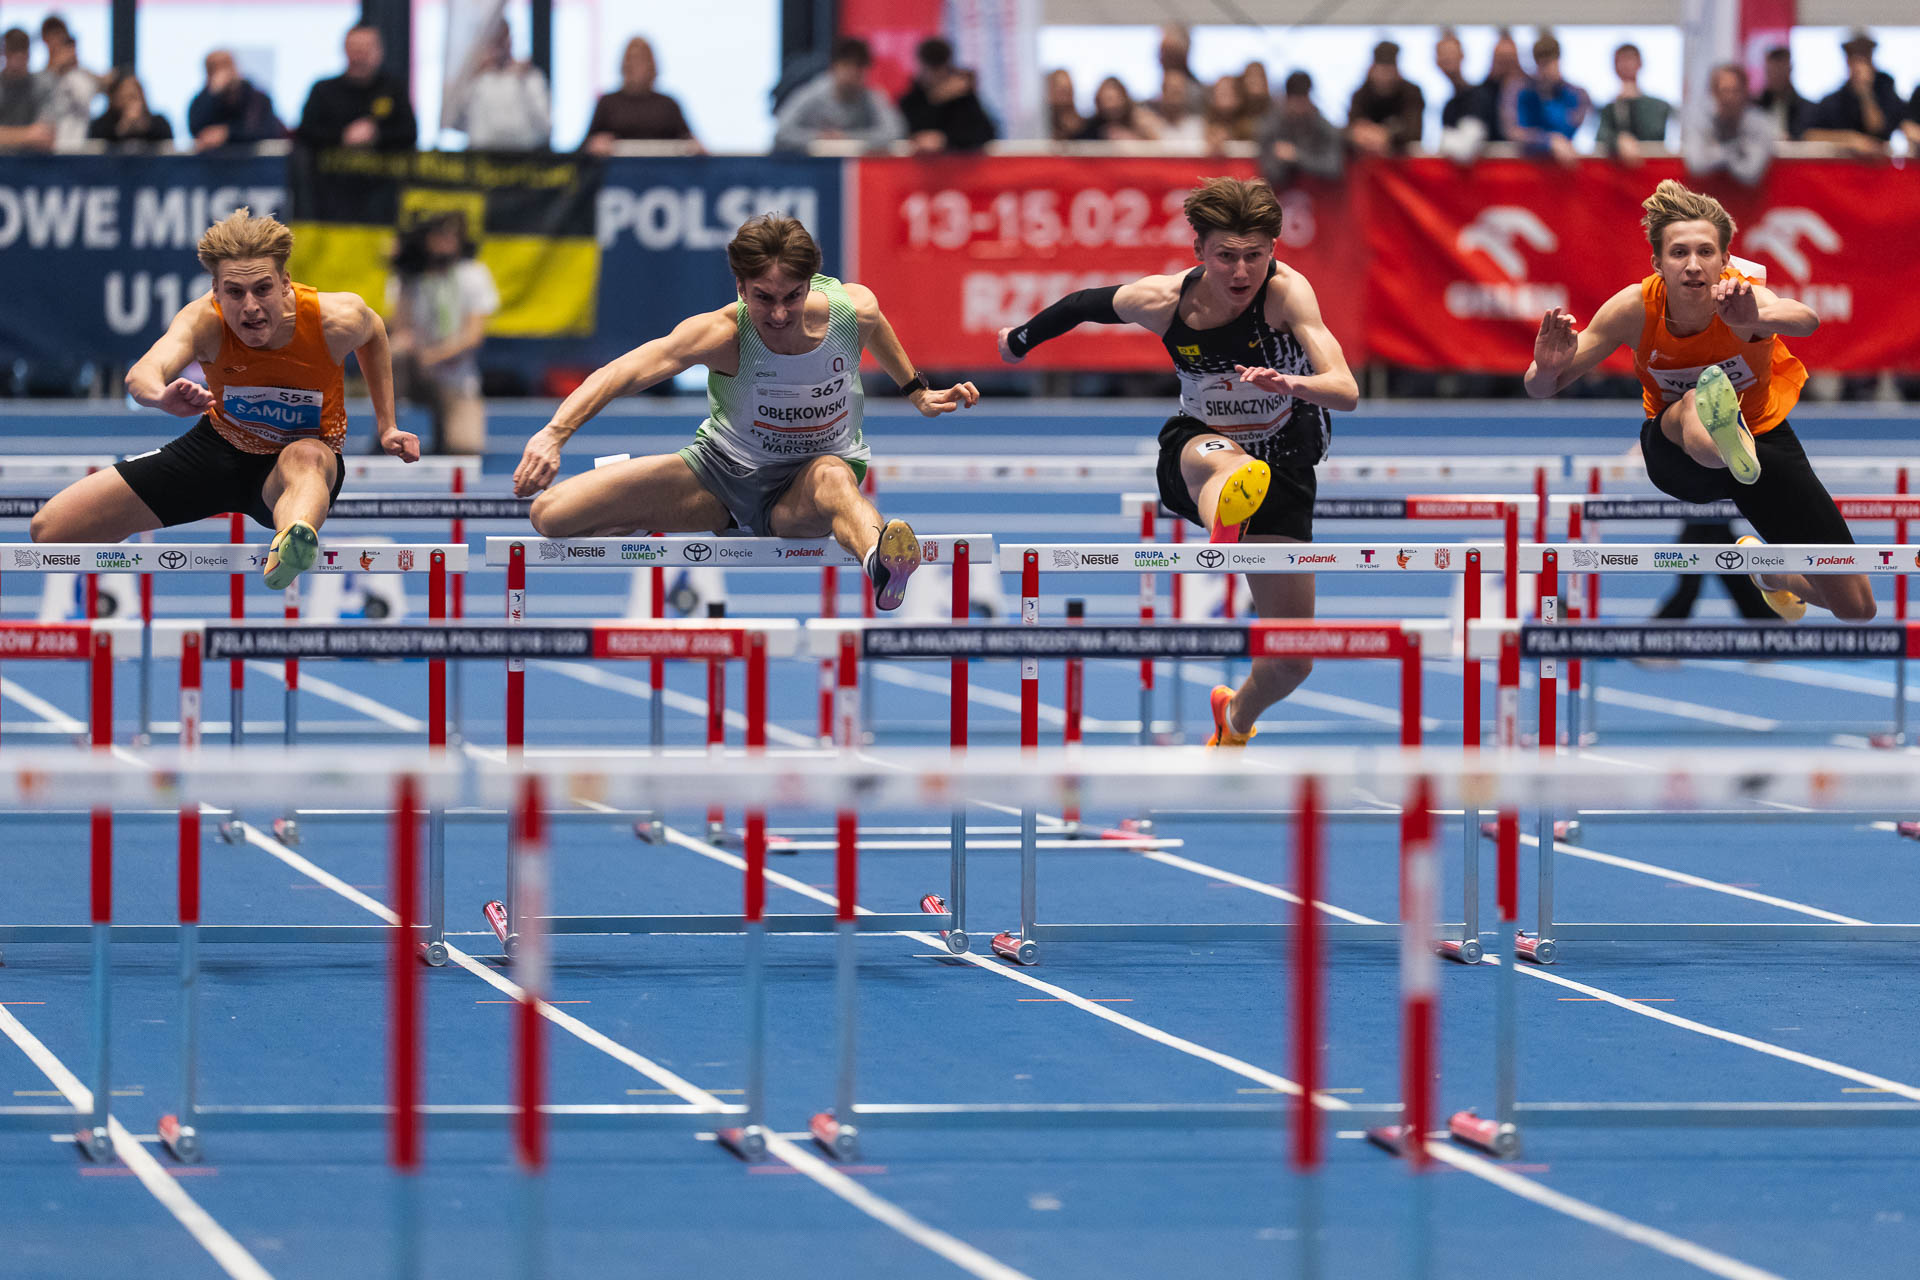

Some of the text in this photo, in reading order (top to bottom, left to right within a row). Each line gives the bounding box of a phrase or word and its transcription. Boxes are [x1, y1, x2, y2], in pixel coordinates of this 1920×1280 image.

[811, 378, 844, 398] 367
[279, 391, 313, 403] 555
[235, 403, 306, 424] SAMUL
[758, 396, 846, 423] OBŁĘKOWSKI
[1205, 440, 1225, 450] 5
[621, 544, 650, 552] GRUPA
[785, 547, 825, 559] polanik
[96, 552, 125, 560] GRUPA
[621, 552, 656, 560] LUXMED
[719, 549, 753, 560] Okęcie
[1134, 551, 1164, 559] GRUPA
[1232, 554, 1266, 565] Okęcie
[1298, 553, 1337, 565] polanik
[1654, 552, 1683, 560] GRUPA
[96, 560, 131, 568] LUXMED
[194, 556, 228, 567] Okęcie
[1134, 559, 1169, 567] LUXMED
[1653, 560, 1688, 568] LUXMED
[1751, 556, 1785, 567] Okęcie
[1816, 556, 1855, 567] polanik
